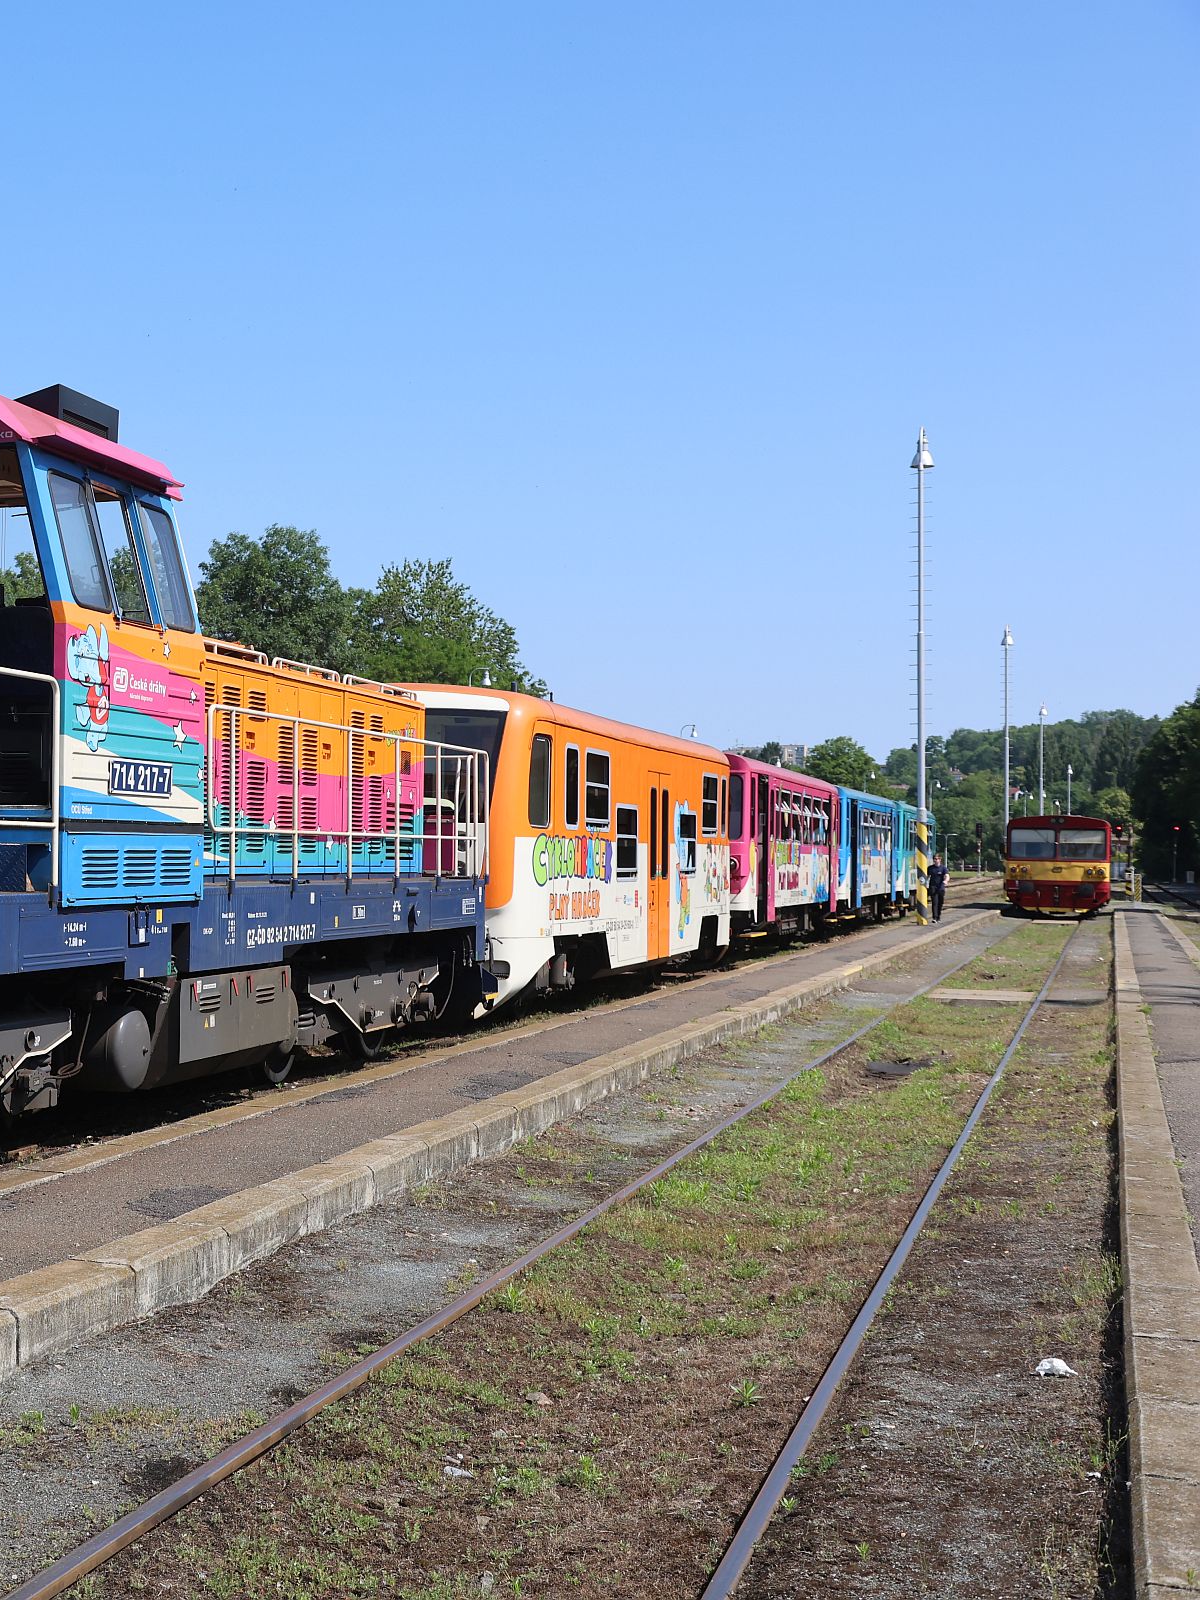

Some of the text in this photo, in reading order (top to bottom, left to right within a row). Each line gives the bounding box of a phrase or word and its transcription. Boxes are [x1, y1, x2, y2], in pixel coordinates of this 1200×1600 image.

[130, 673, 167, 697] České dráhy
[113, 763, 170, 792] 714 217-7
[267, 927, 275, 944] 92
[283, 926, 288, 942] 2
[288, 924, 300, 941] 714
[300, 923, 316, 940] 217-7
